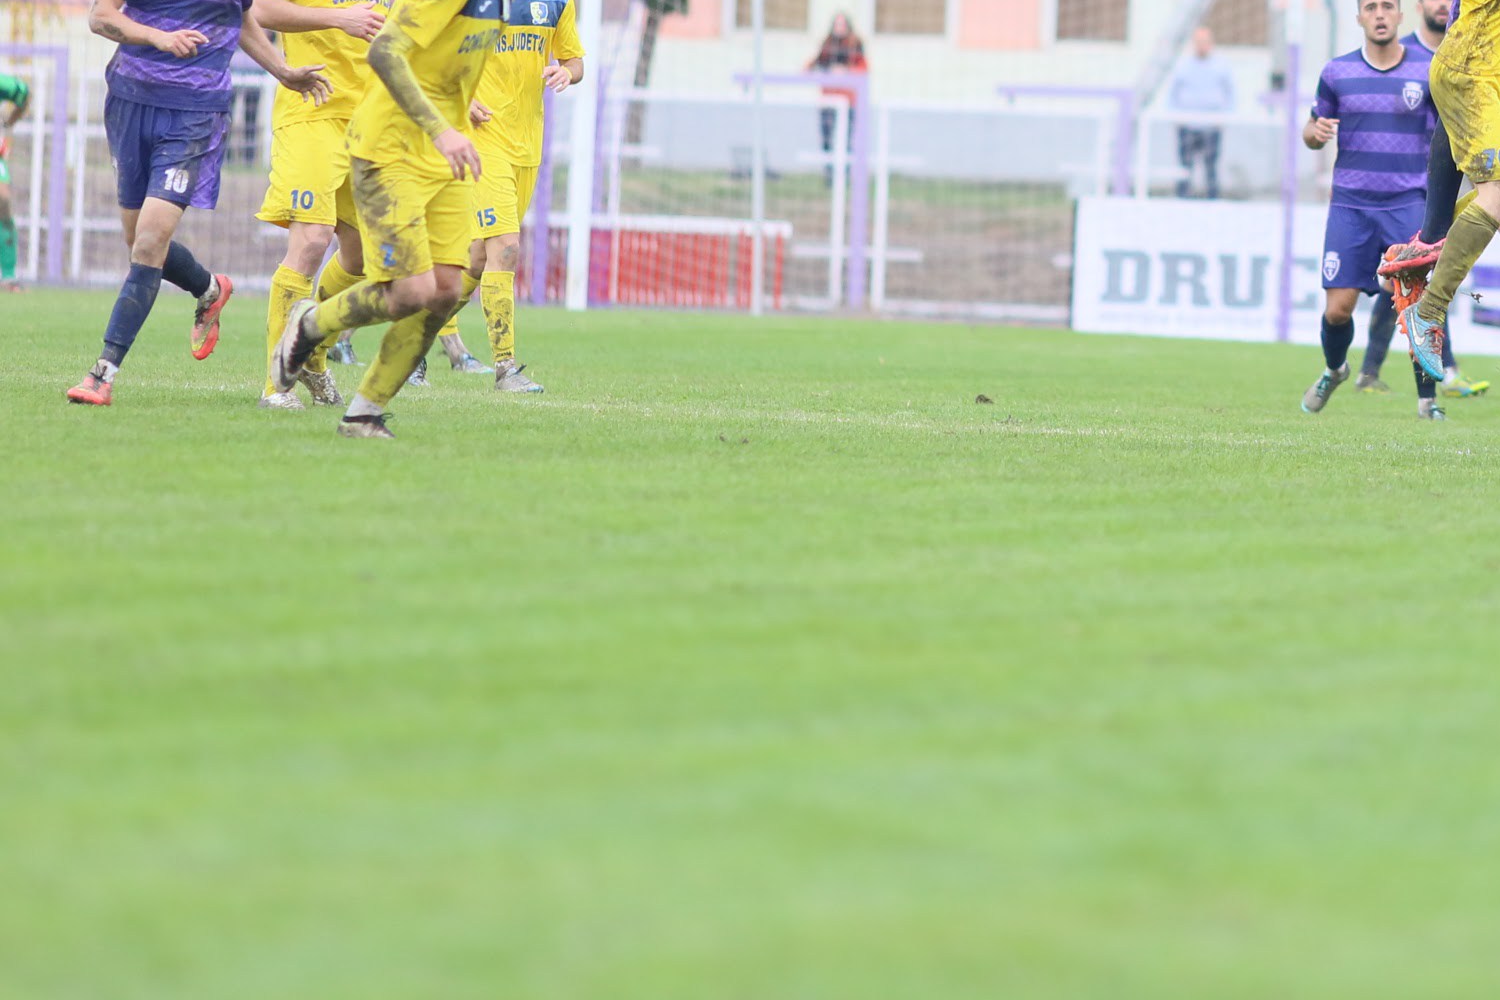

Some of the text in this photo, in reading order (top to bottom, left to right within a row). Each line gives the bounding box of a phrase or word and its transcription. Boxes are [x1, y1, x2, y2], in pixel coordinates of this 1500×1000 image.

[164, 167, 189, 193] 10
[290, 189, 315, 210] 10
[476, 207, 497, 228] 15
